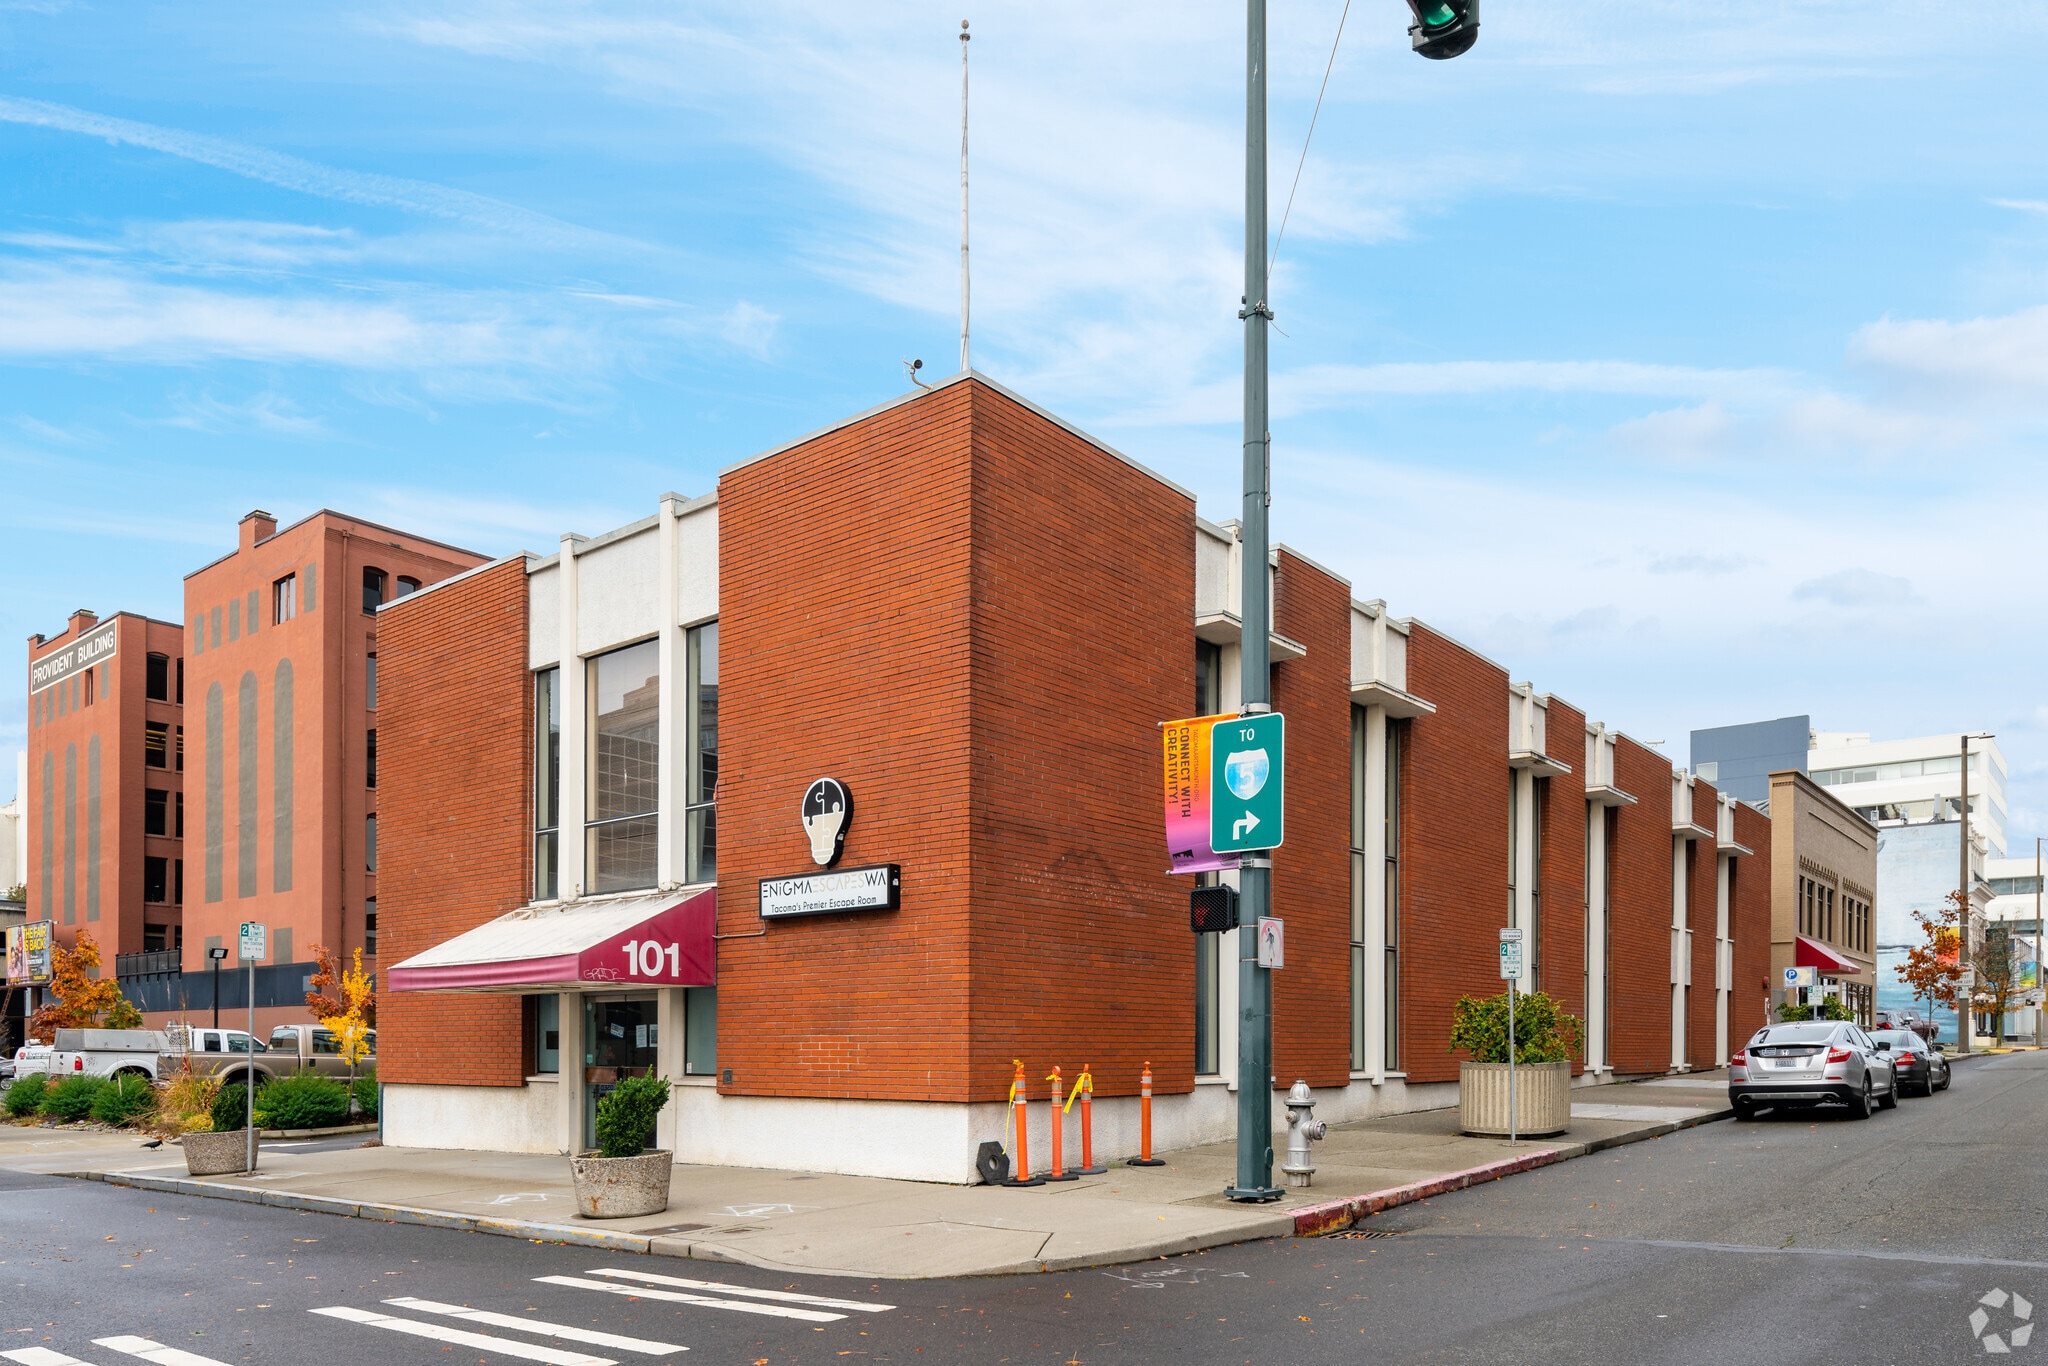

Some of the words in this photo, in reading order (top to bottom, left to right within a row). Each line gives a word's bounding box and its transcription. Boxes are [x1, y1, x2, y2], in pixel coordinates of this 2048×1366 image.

[33, 651, 74, 685] PROVIDENT
[78, 631, 114, 664] BUILDING
[1240, 728, 1254, 742] TO
[1168, 729, 1178, 804] CREATIVITY!
[1180, 727, 1190, 782] CONNECT
[1240, 763, 1255, 790] 5
[1181, 786, 1191, 818] WITH
[771, 904, 800, 914] Tacoma's
[803, 901, 827, 910] Premier
[830, 898, 856, 908] Escape
[858, 896, 876, 905] Room
[24, 927, 33, 940] THE
[34, 925, 46, 938] FAIR
[242, 926, 248, 935] 2
[622, 940, 679, 977] 101
[1502, 944, 1506, 954] 2
